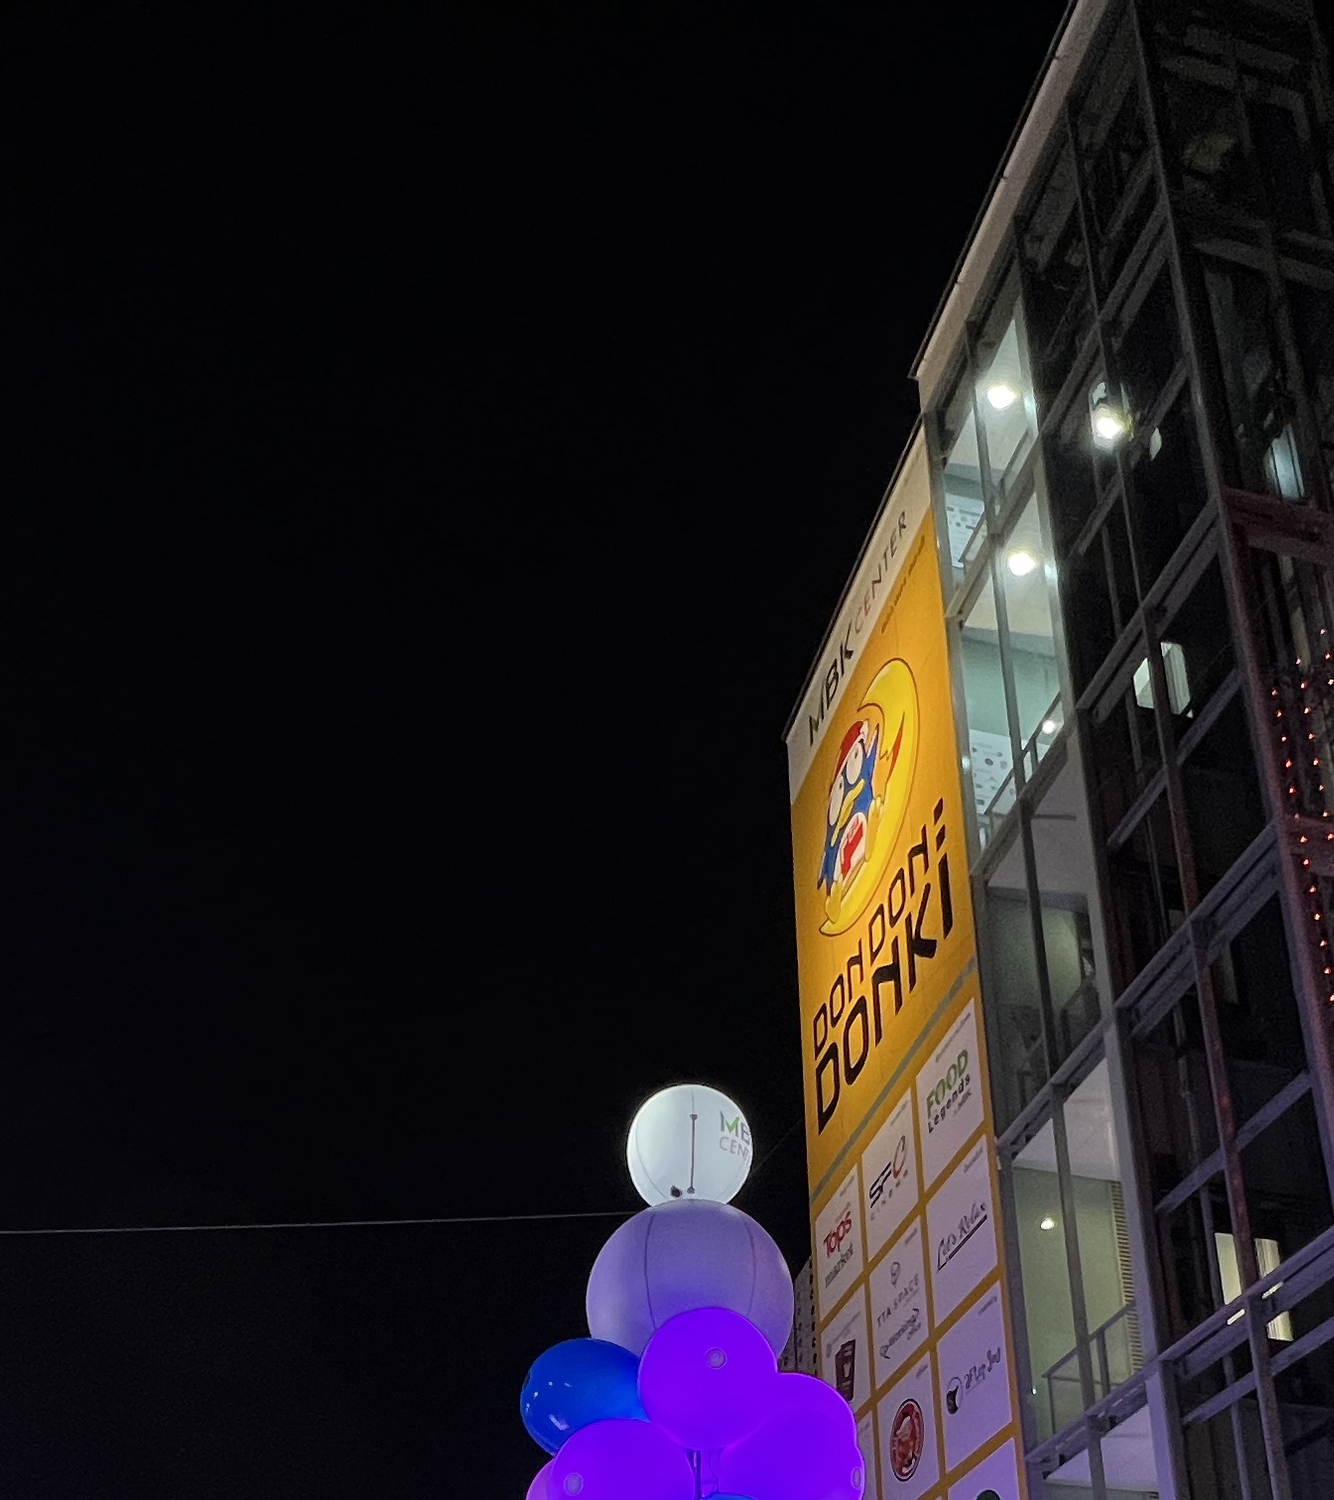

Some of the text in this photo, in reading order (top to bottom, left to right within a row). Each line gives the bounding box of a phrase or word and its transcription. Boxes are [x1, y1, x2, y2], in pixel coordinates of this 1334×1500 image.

[809, 621, 853, 747] MBK
[854, 511, 908, 634] CENTER
[813, 938, 864, 1060] DON
[926, 1049, 969, 1120] FOOD
[927, 1073, 971, 1134] Legends
[823, 1210, 853, 1259] Tops
